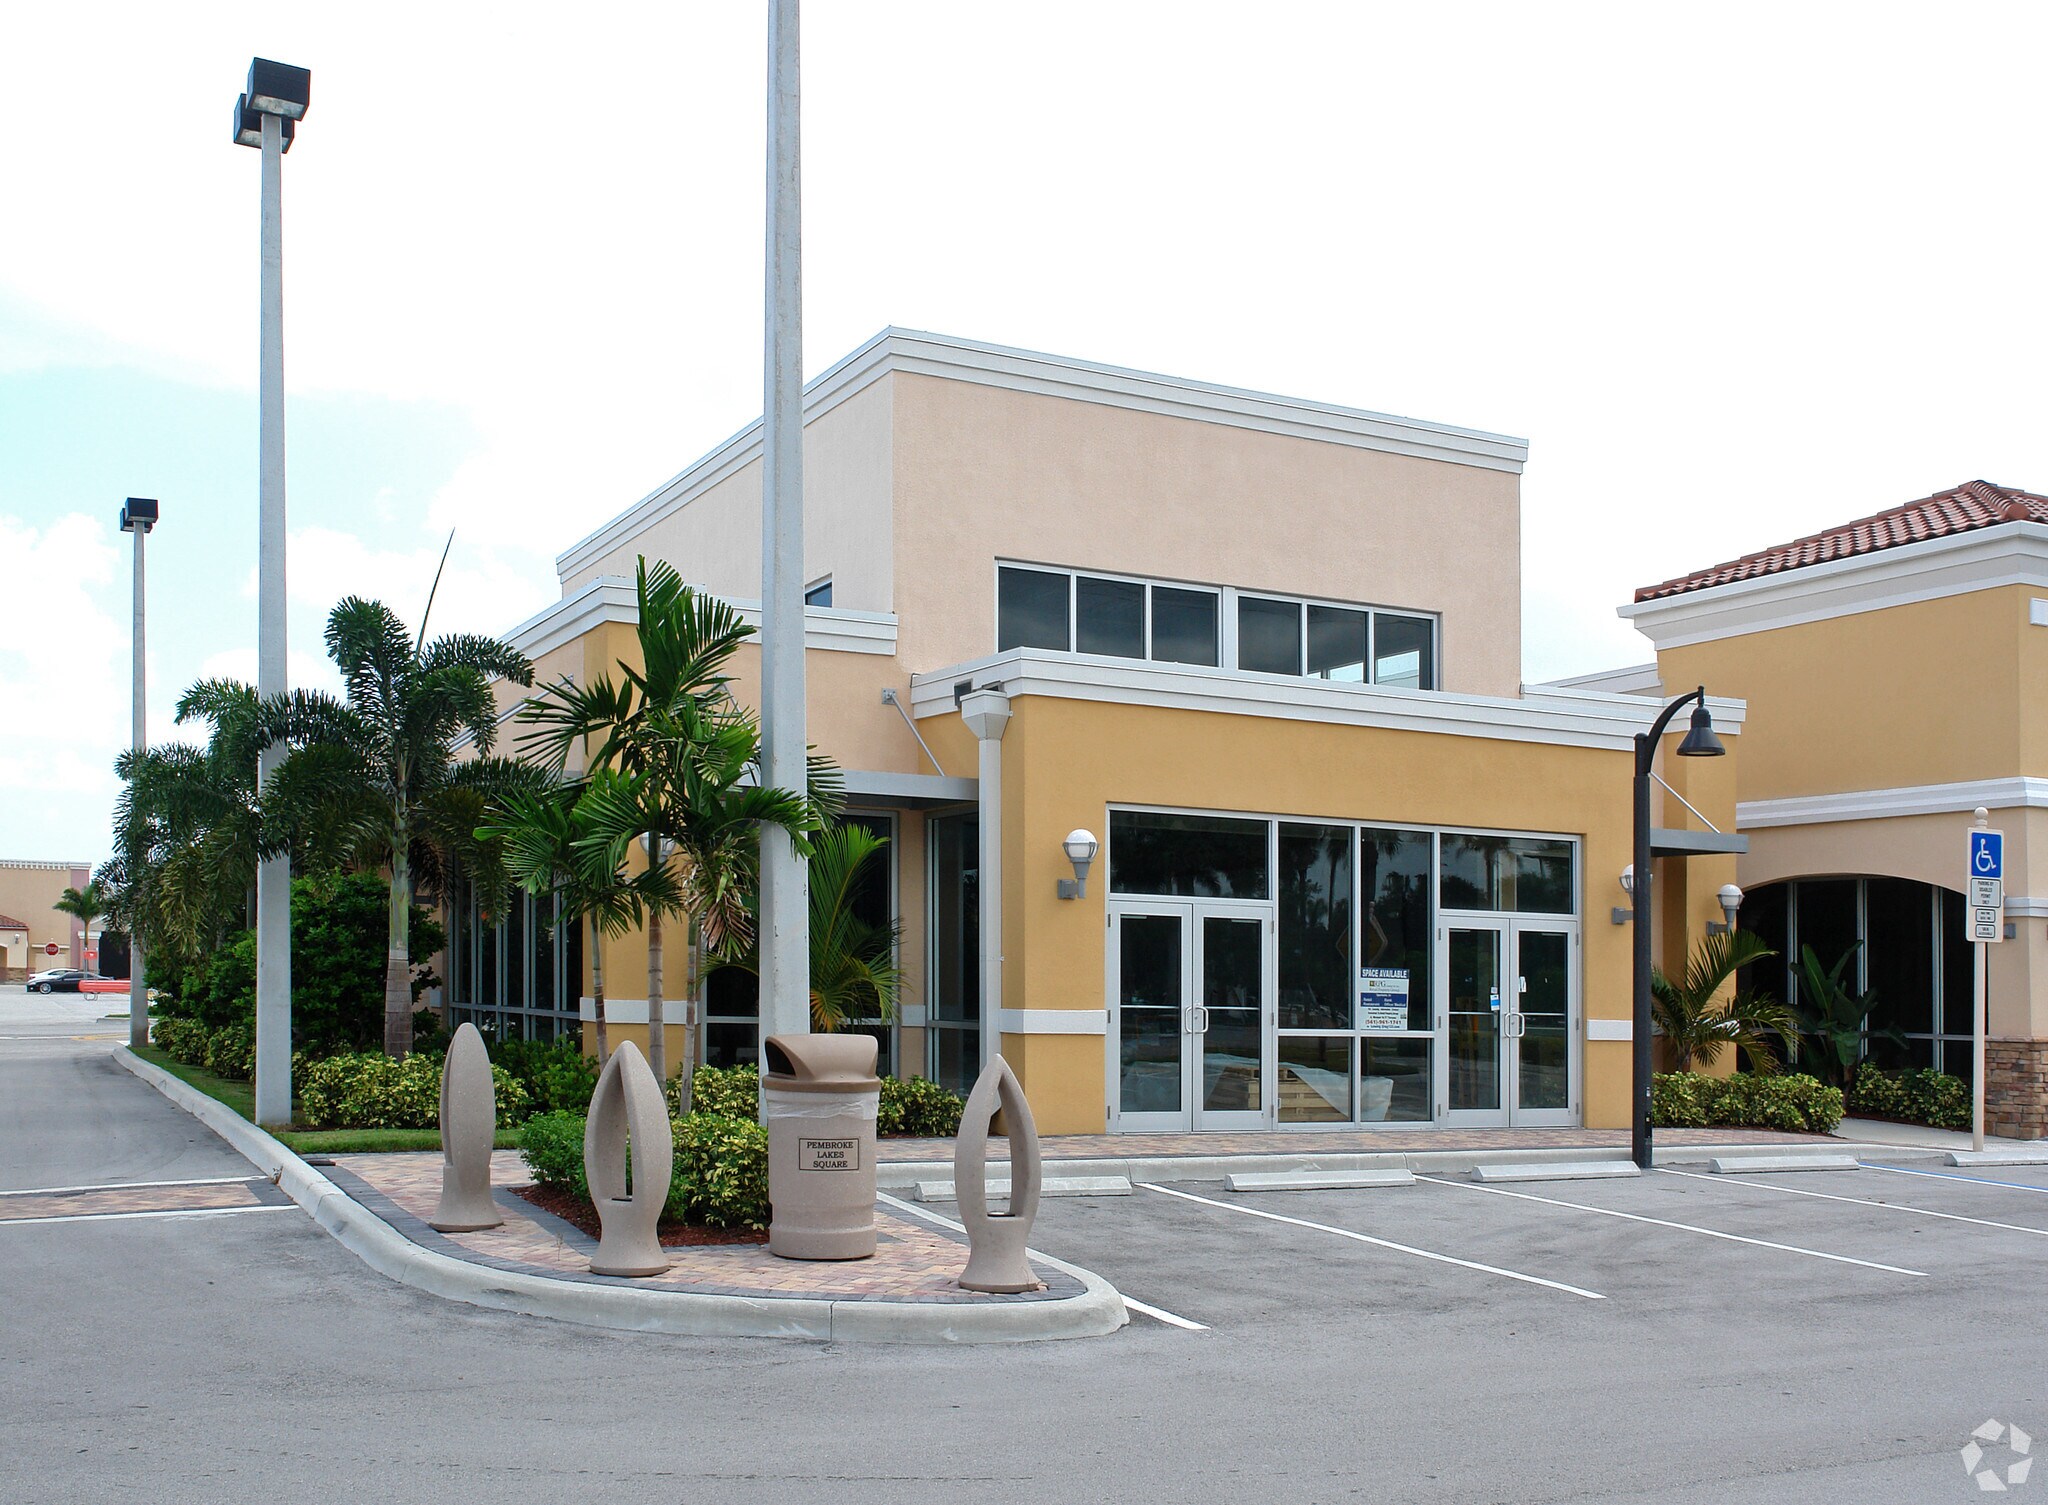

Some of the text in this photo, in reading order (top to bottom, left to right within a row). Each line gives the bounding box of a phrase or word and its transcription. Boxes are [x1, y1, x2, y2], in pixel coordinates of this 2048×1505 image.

[1362, 969, 1407, 979] SPACE AVAILABLE
[807, 1141, 853, 1149] PEMBROKE
[817, 1151, 844, 1159] LAKES
[813, 1160, 848, 1169] SQUARE
